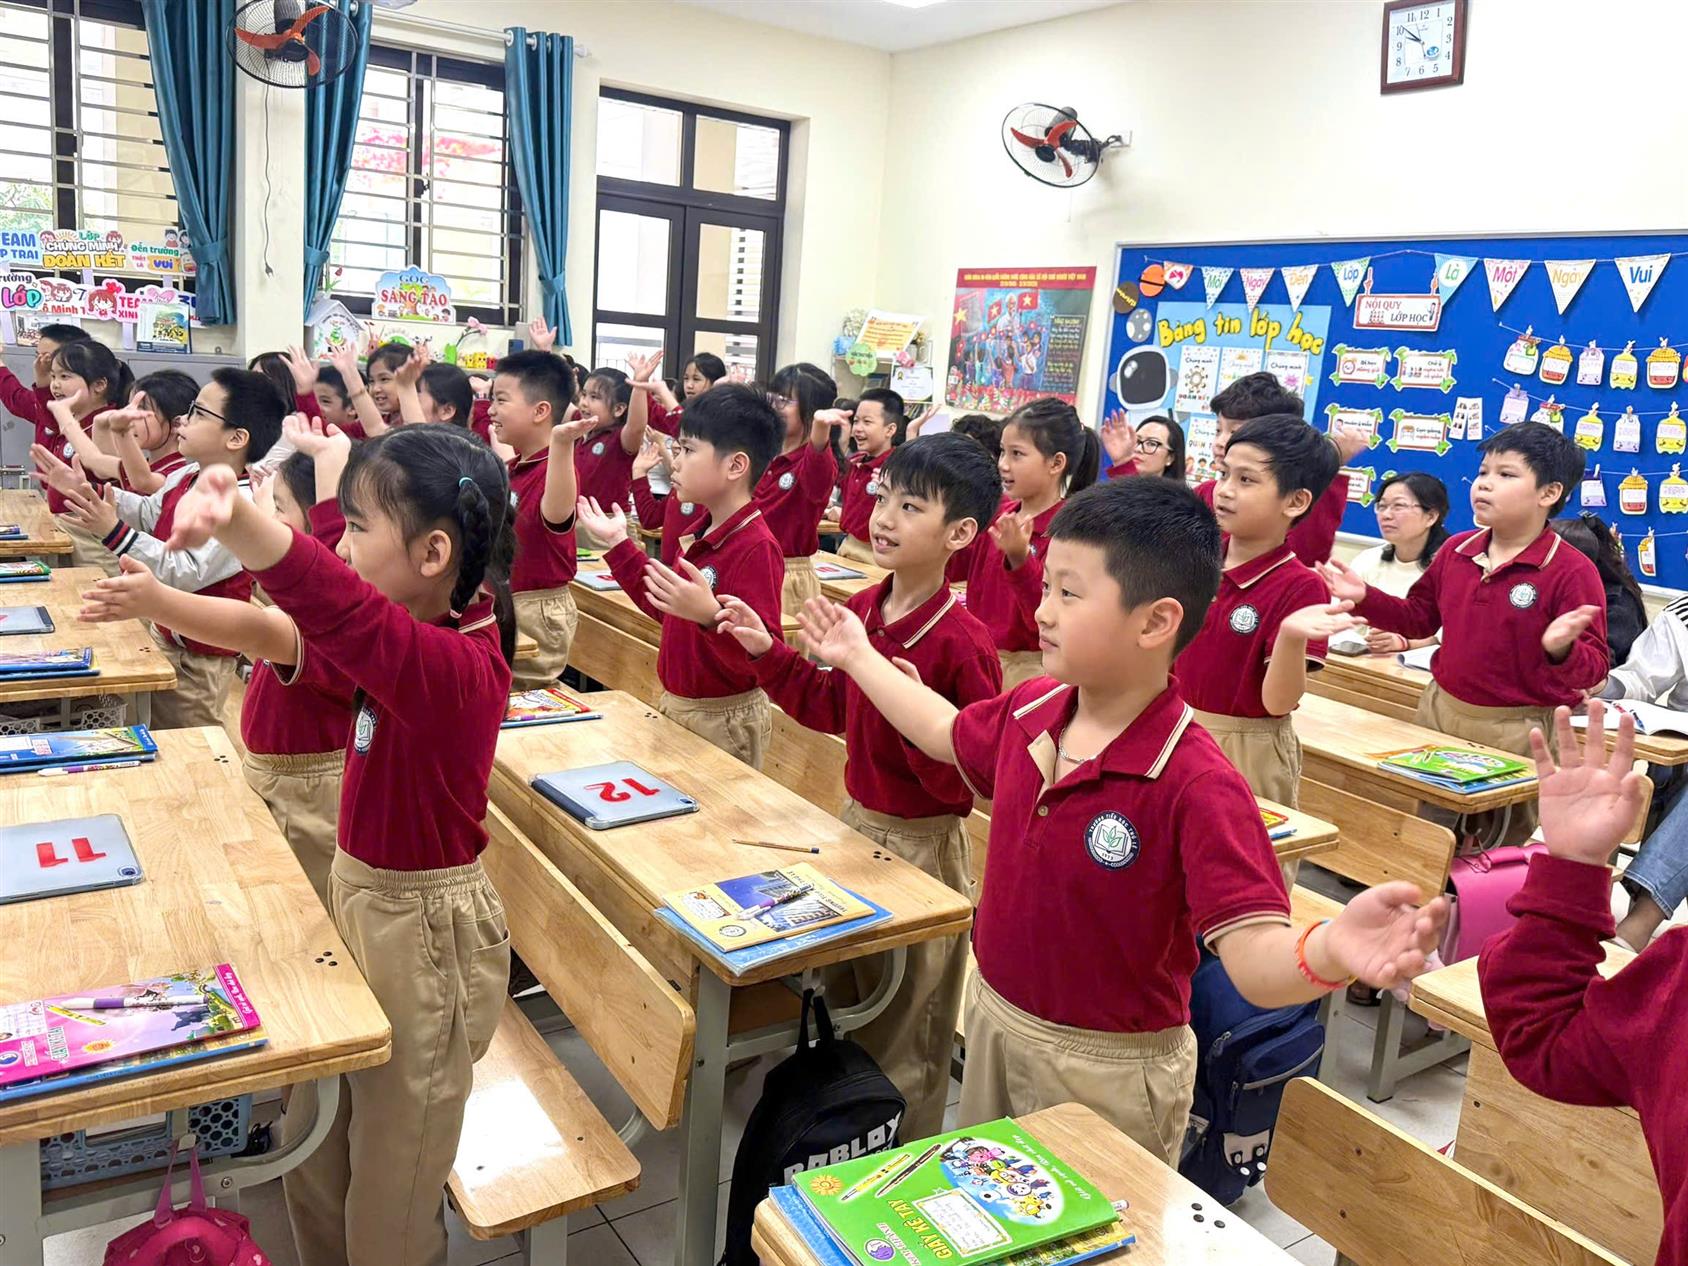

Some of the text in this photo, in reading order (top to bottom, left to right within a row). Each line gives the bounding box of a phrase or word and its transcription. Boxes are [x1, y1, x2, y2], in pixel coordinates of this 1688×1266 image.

[1407, 12, 1414, 22] 11
[1420, 10, 1430, 20] 12
[1437, 8, 1440, 17] 1
[1447, 17, 1453, 26] 2
[1446, 34, 1452, 44] 3
[1397, 42, 1402, 51] 9
[1445, 51, 1450, 60] 4
[1396, 57, 1401, 67] 8
[1405, 67, 1411, 77] 7
[1419, 65, 1425, 75] 6
[1432, 64, 1439, 73] 5
[2, 232, 36, 247] EAM
[45, 241, 86, 252] CHÚNG
[10, 249, 39, 260] TRAI
[43, 250, 126, 268] ĐOÀN KẾT
[1445, 263, 1460, 281] Là
[1492, 265, 1517, 288] Một
[1630, 265, 1653, 284] Vui
[0, 272, 32, 284] ường
[119, 296, 140, 308] TE
[1365, 298, 1402, 311] NỘI QUY
[51, 305, 79, 315] Minh
[1391, 311, 1428, 325] LỚP HỌC
[1157, 306, 1325, 356] Bảng tin lớp học
[584, 778, 660, 802] 12
[36, 837, 106, 868] 11
[784, 1110, 902, 1185] ROBLOX
[888, 1197, 914, 1217] TAY
